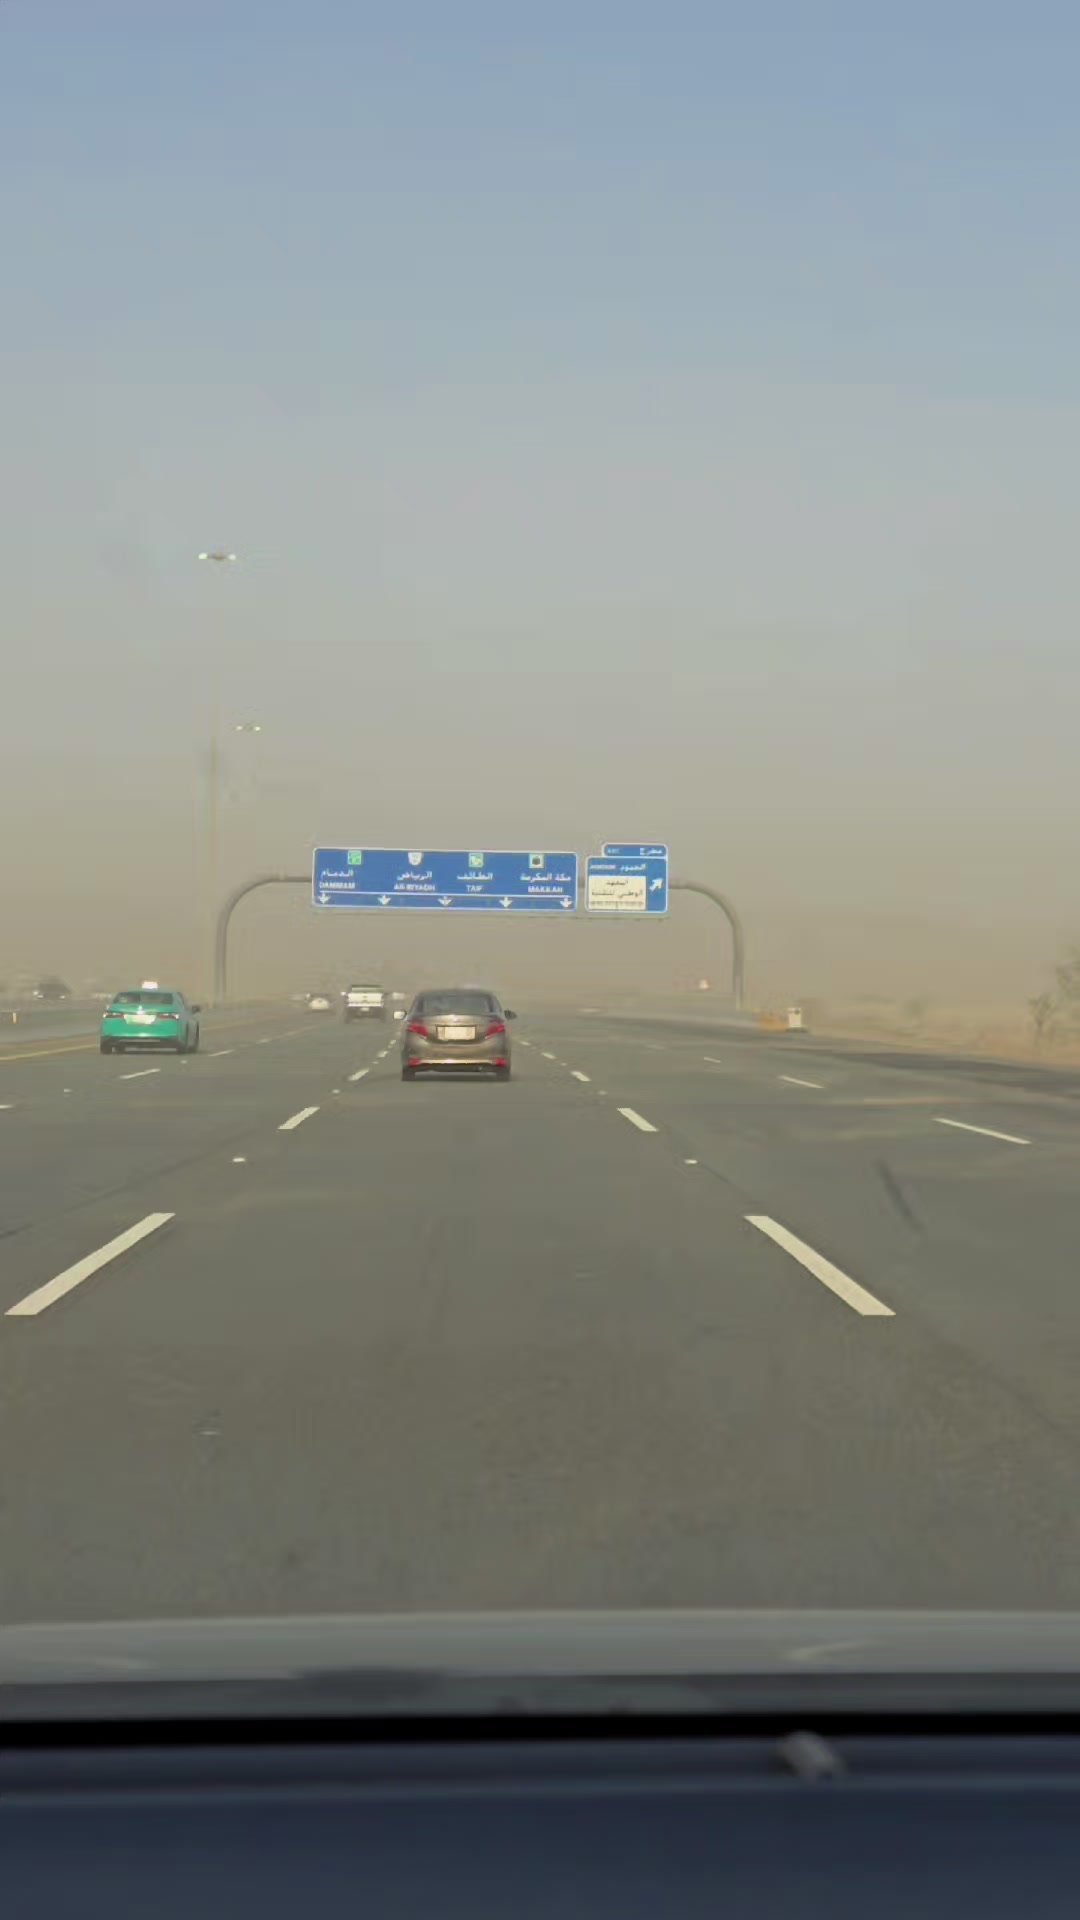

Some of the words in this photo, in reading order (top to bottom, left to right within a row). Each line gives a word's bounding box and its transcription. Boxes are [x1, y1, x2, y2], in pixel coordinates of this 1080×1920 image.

[321, 868, 354, 880] الدمام
[397, 871, 433, 881] الرياض
[520, 872, 553, 883] المكرمة
[555, 873, 571, 881] مكة
[319, 881, 356, 889] DAMMAM
[466, 884, 483, 892] TAIF
[527, 885, 563, 893] MAKKAH
